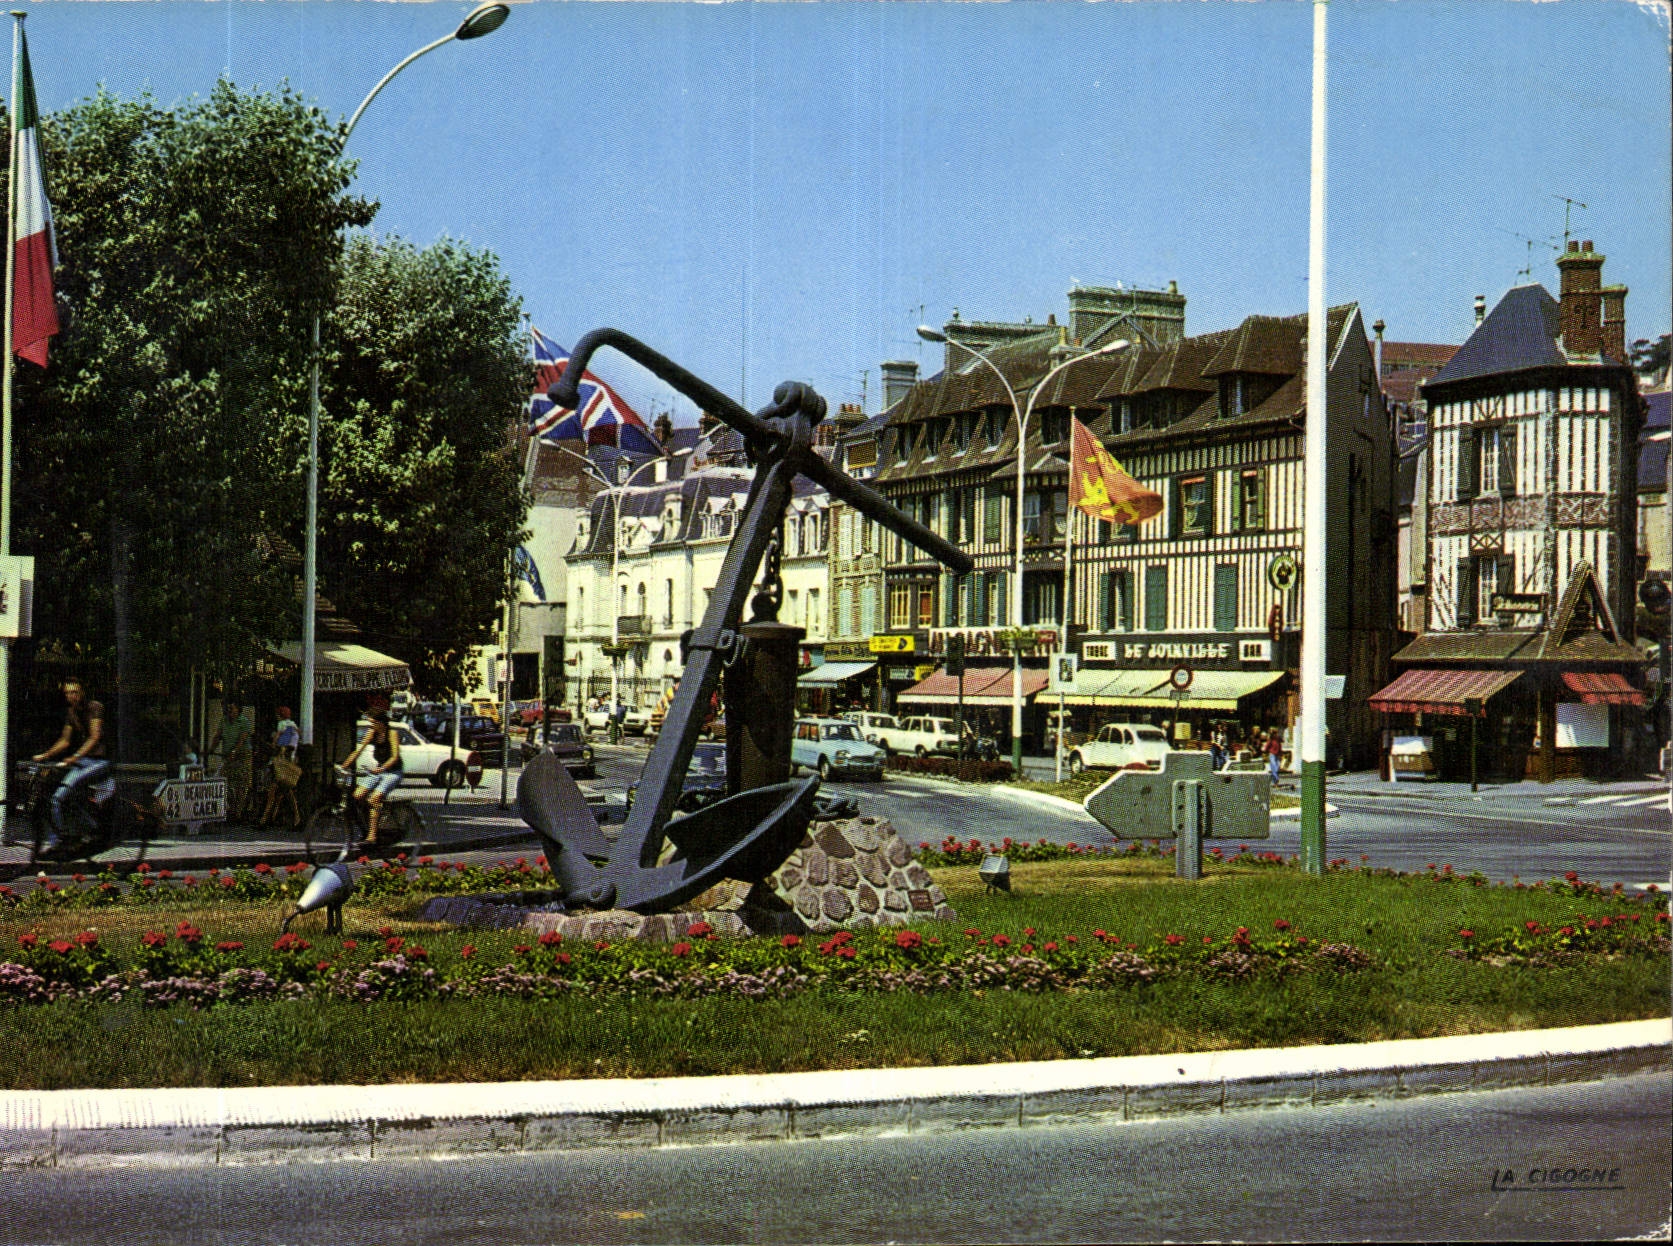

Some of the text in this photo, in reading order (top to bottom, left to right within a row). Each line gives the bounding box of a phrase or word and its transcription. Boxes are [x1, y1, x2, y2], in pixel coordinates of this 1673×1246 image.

[1148, 642, 1229, 659] JOINVILLE
[184, 784, 224, 801] DEAUVILLE
[193, 801, 218, 816] CAEN
